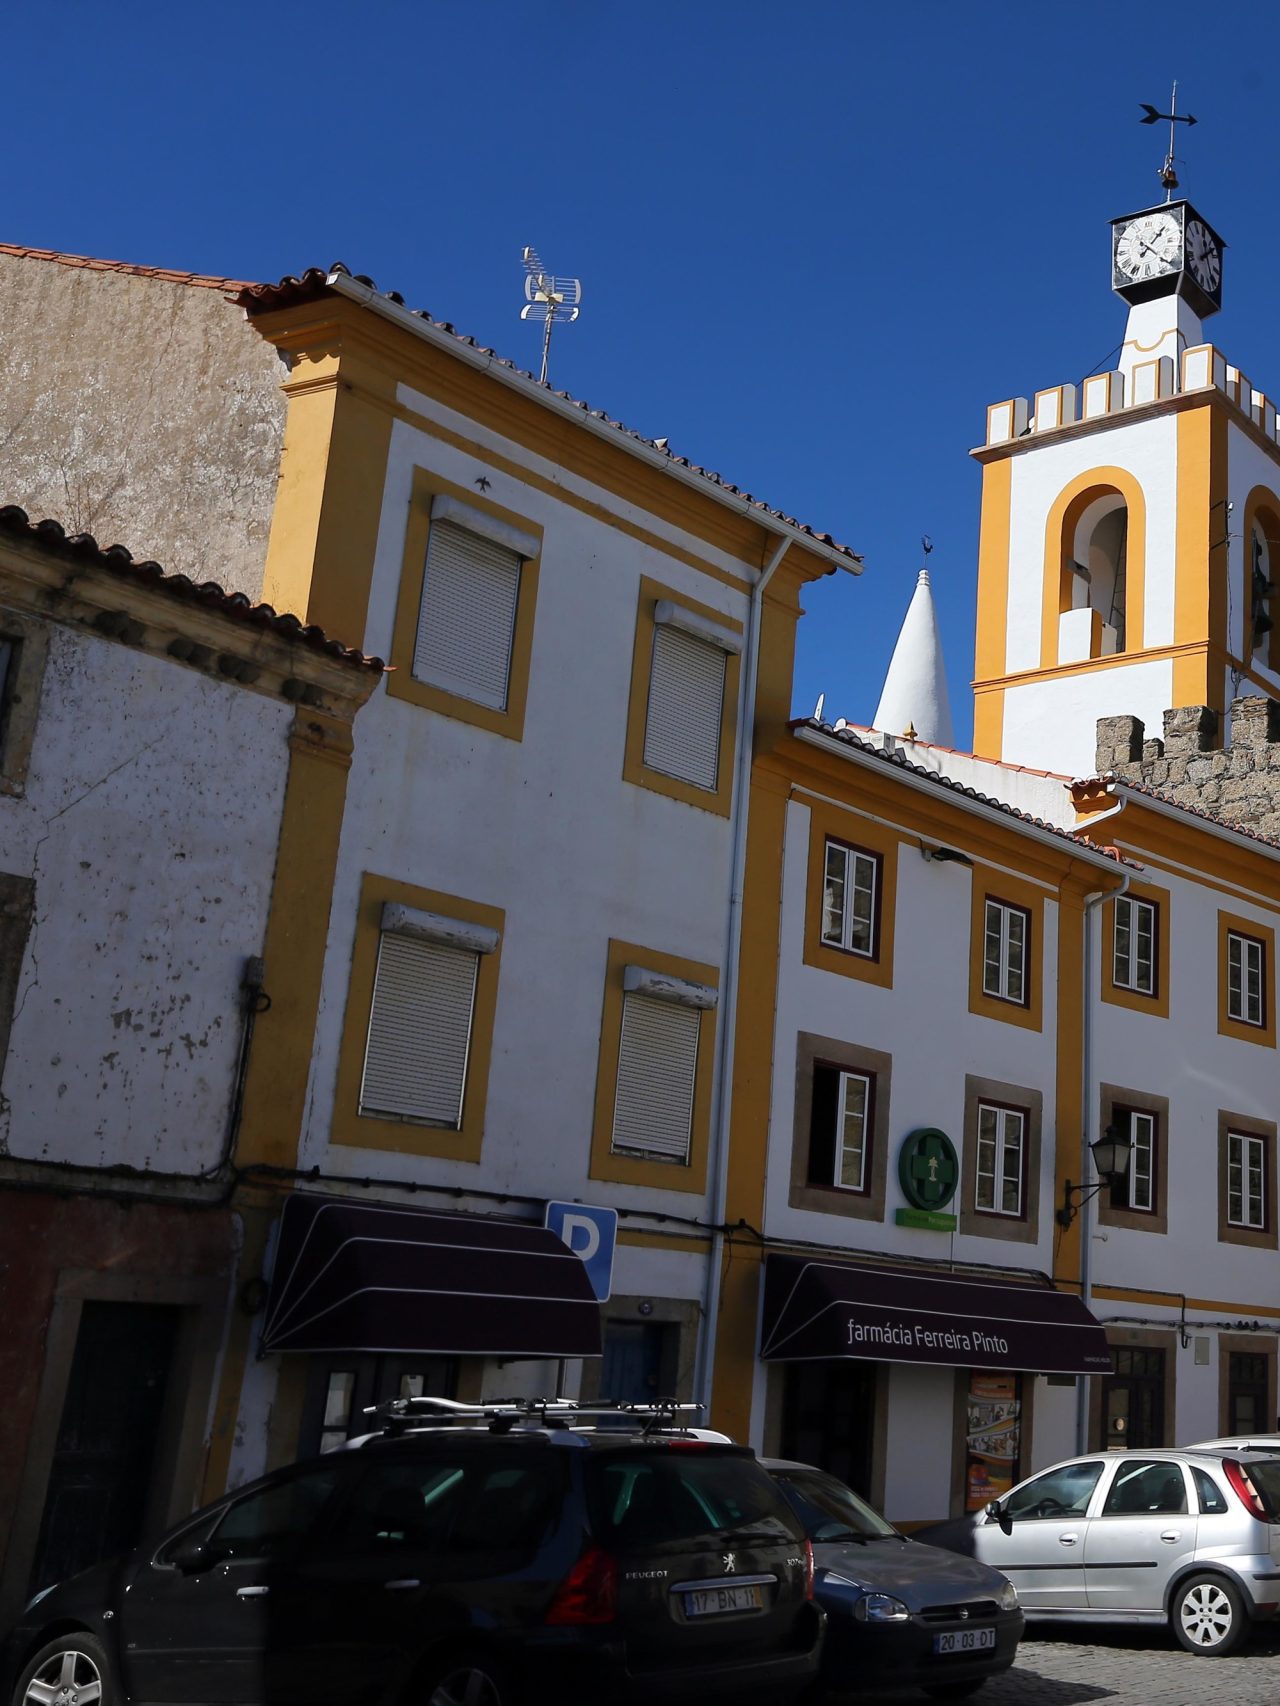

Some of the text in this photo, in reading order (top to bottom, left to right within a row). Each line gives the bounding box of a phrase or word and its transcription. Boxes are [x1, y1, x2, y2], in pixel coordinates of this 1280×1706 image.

[847, 1318, 1009, 1354] farmácia Ferreira Pinto
[625, 1570, 669, 1580] PEUGEOT
